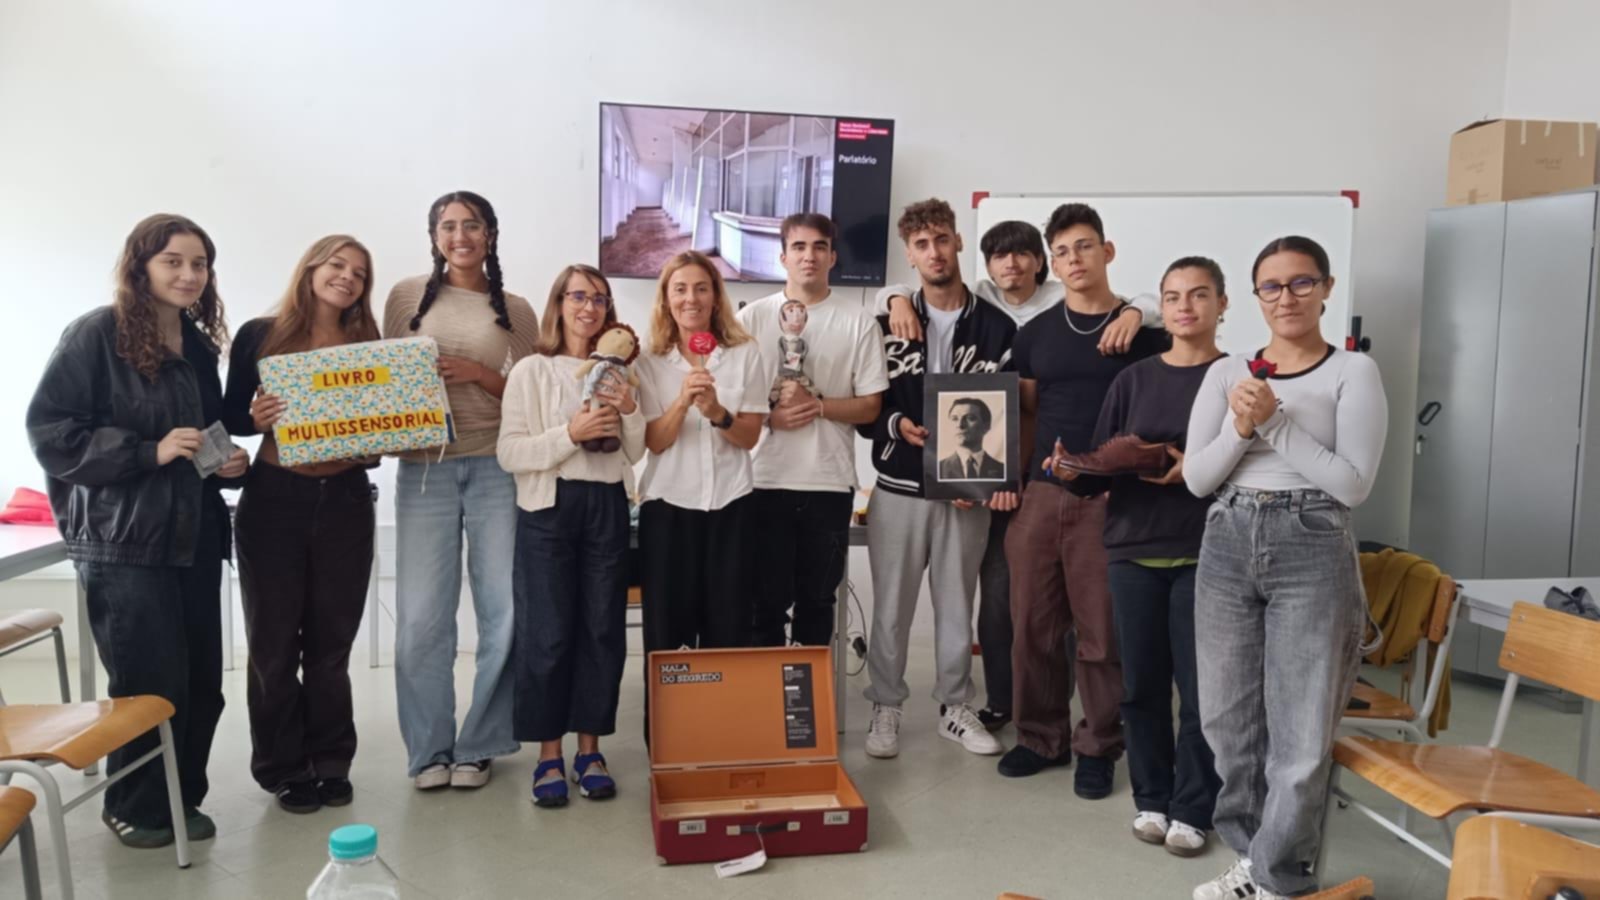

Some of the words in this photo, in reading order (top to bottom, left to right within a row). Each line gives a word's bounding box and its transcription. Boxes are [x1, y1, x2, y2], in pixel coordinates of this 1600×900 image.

[322, 369, 376, 387] LIVRO
[287, 411, 442, 441] MULTISSENSORIAL
[661, 664, 689, 673] MALA
[662, 675, 675, 684] DO
[677, 672, 721, 683] SEGREDO
